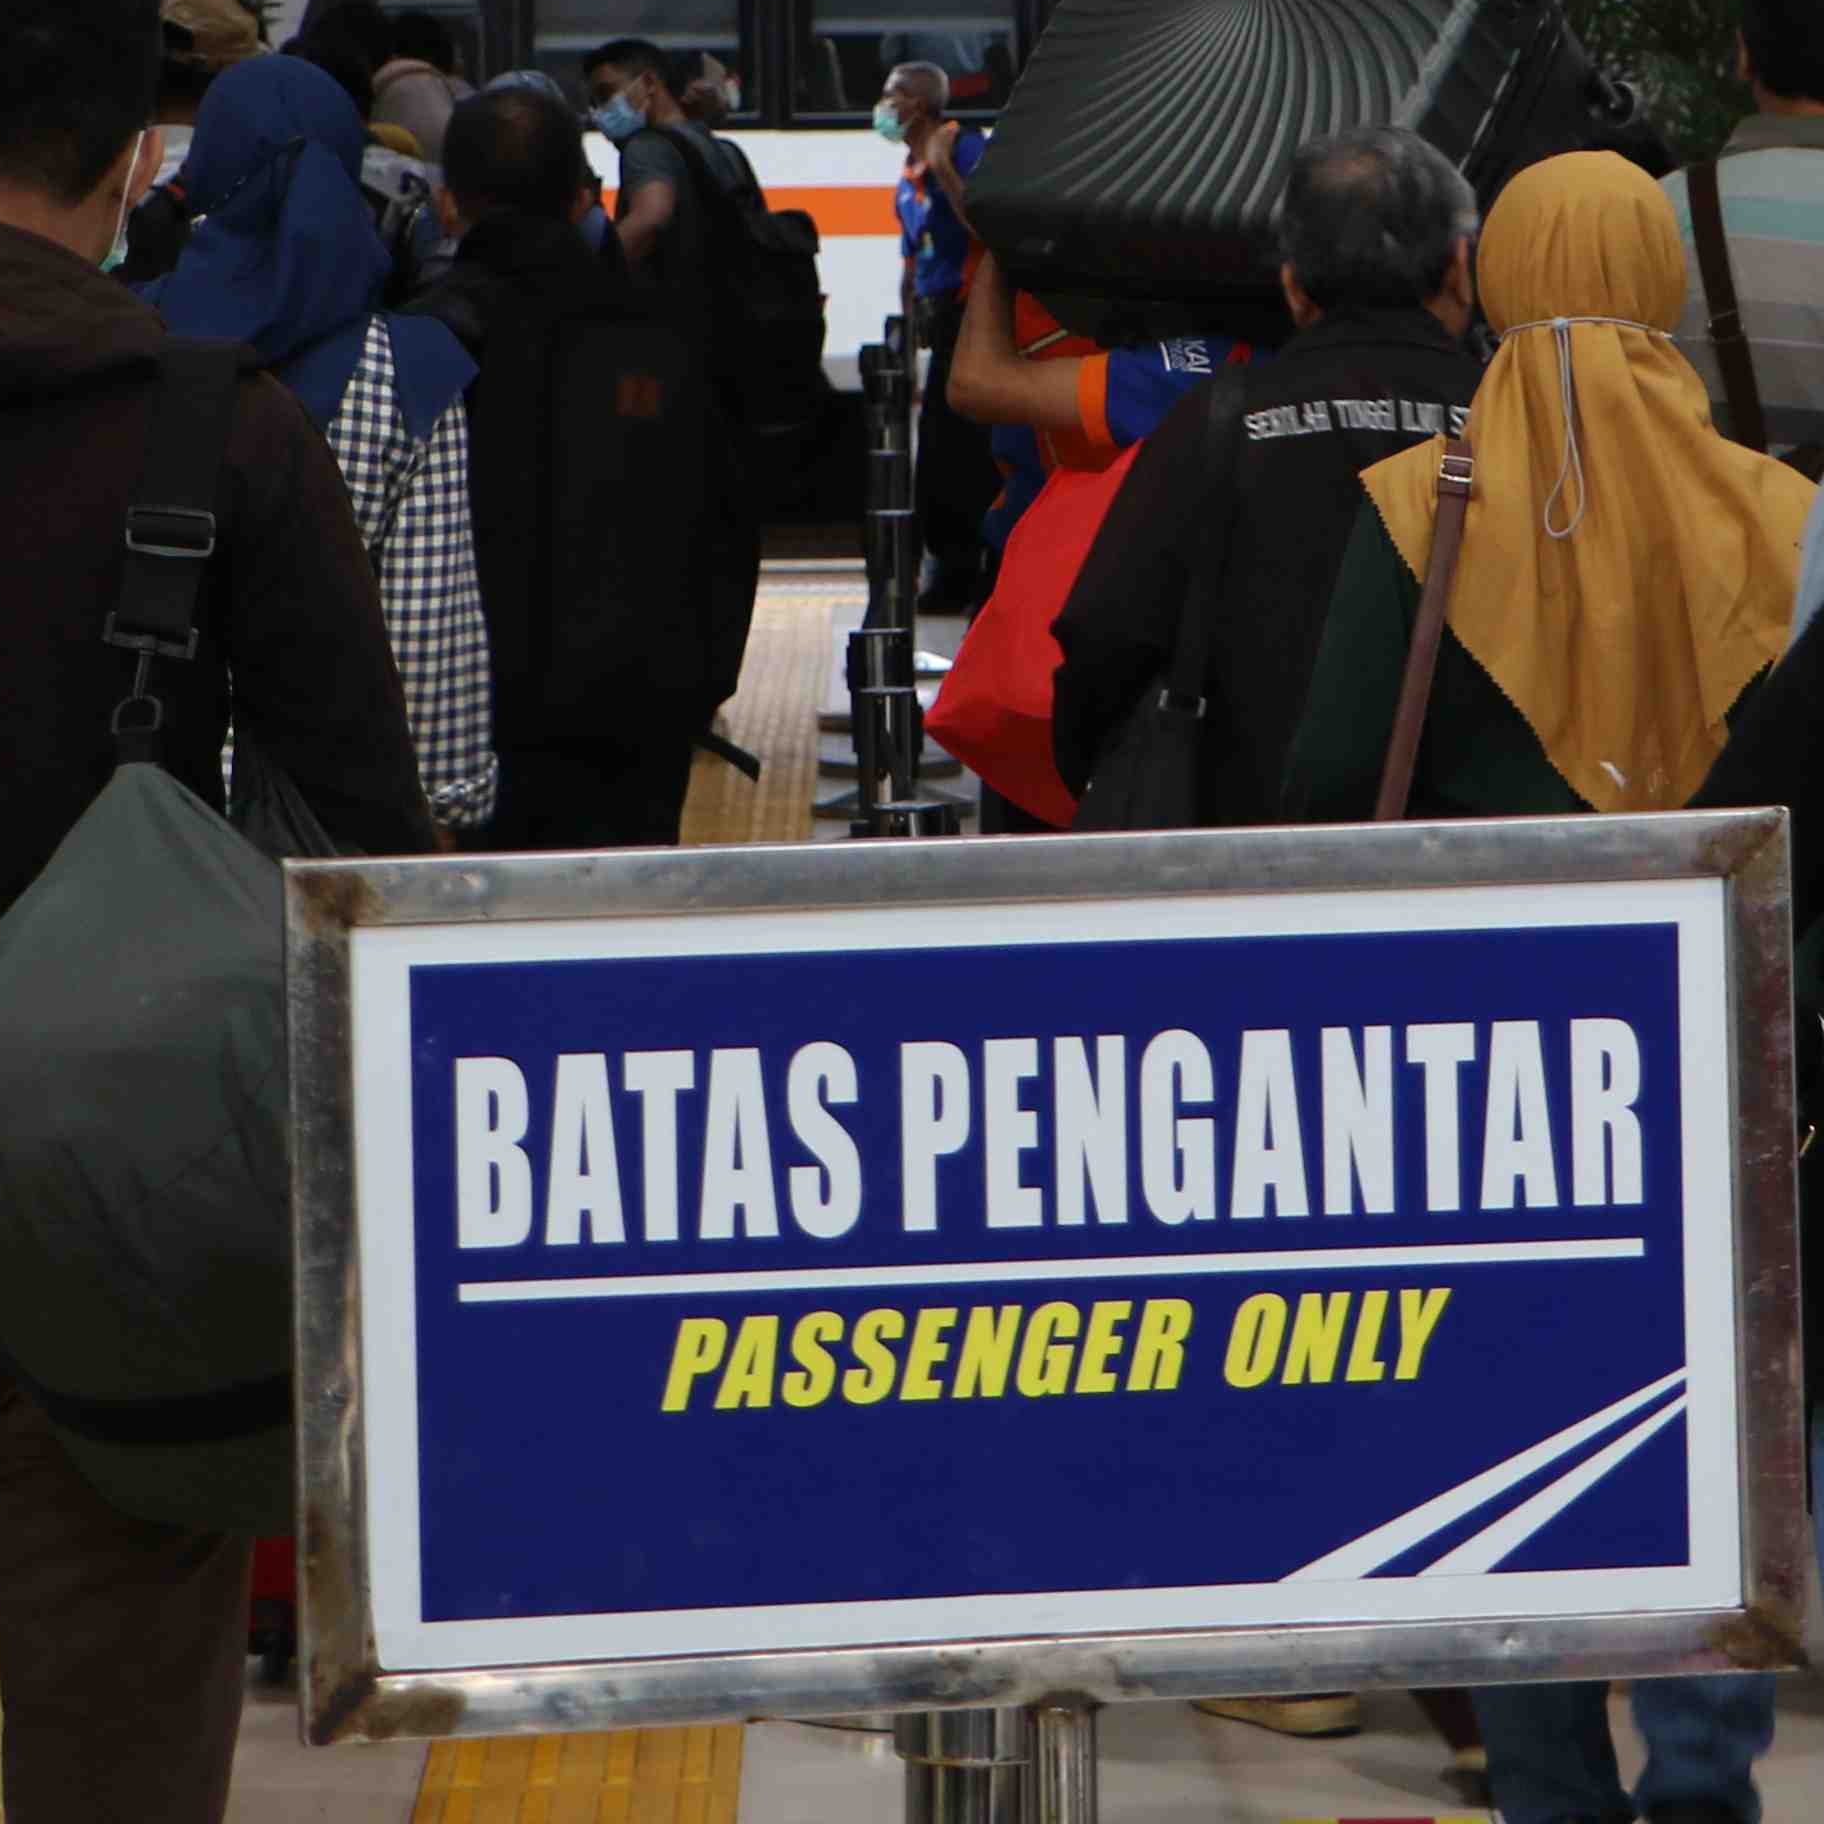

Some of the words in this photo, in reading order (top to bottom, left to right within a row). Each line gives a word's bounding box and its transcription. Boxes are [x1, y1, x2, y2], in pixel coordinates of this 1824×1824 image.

[452, 1039, 865, 1251] BATAS
[897, 1015, 1648, 1233] PENGANTAR
[658, 1295, 1189, 1415] PASSENGER
[1222, 1285, 1452, 1389] ONLY
